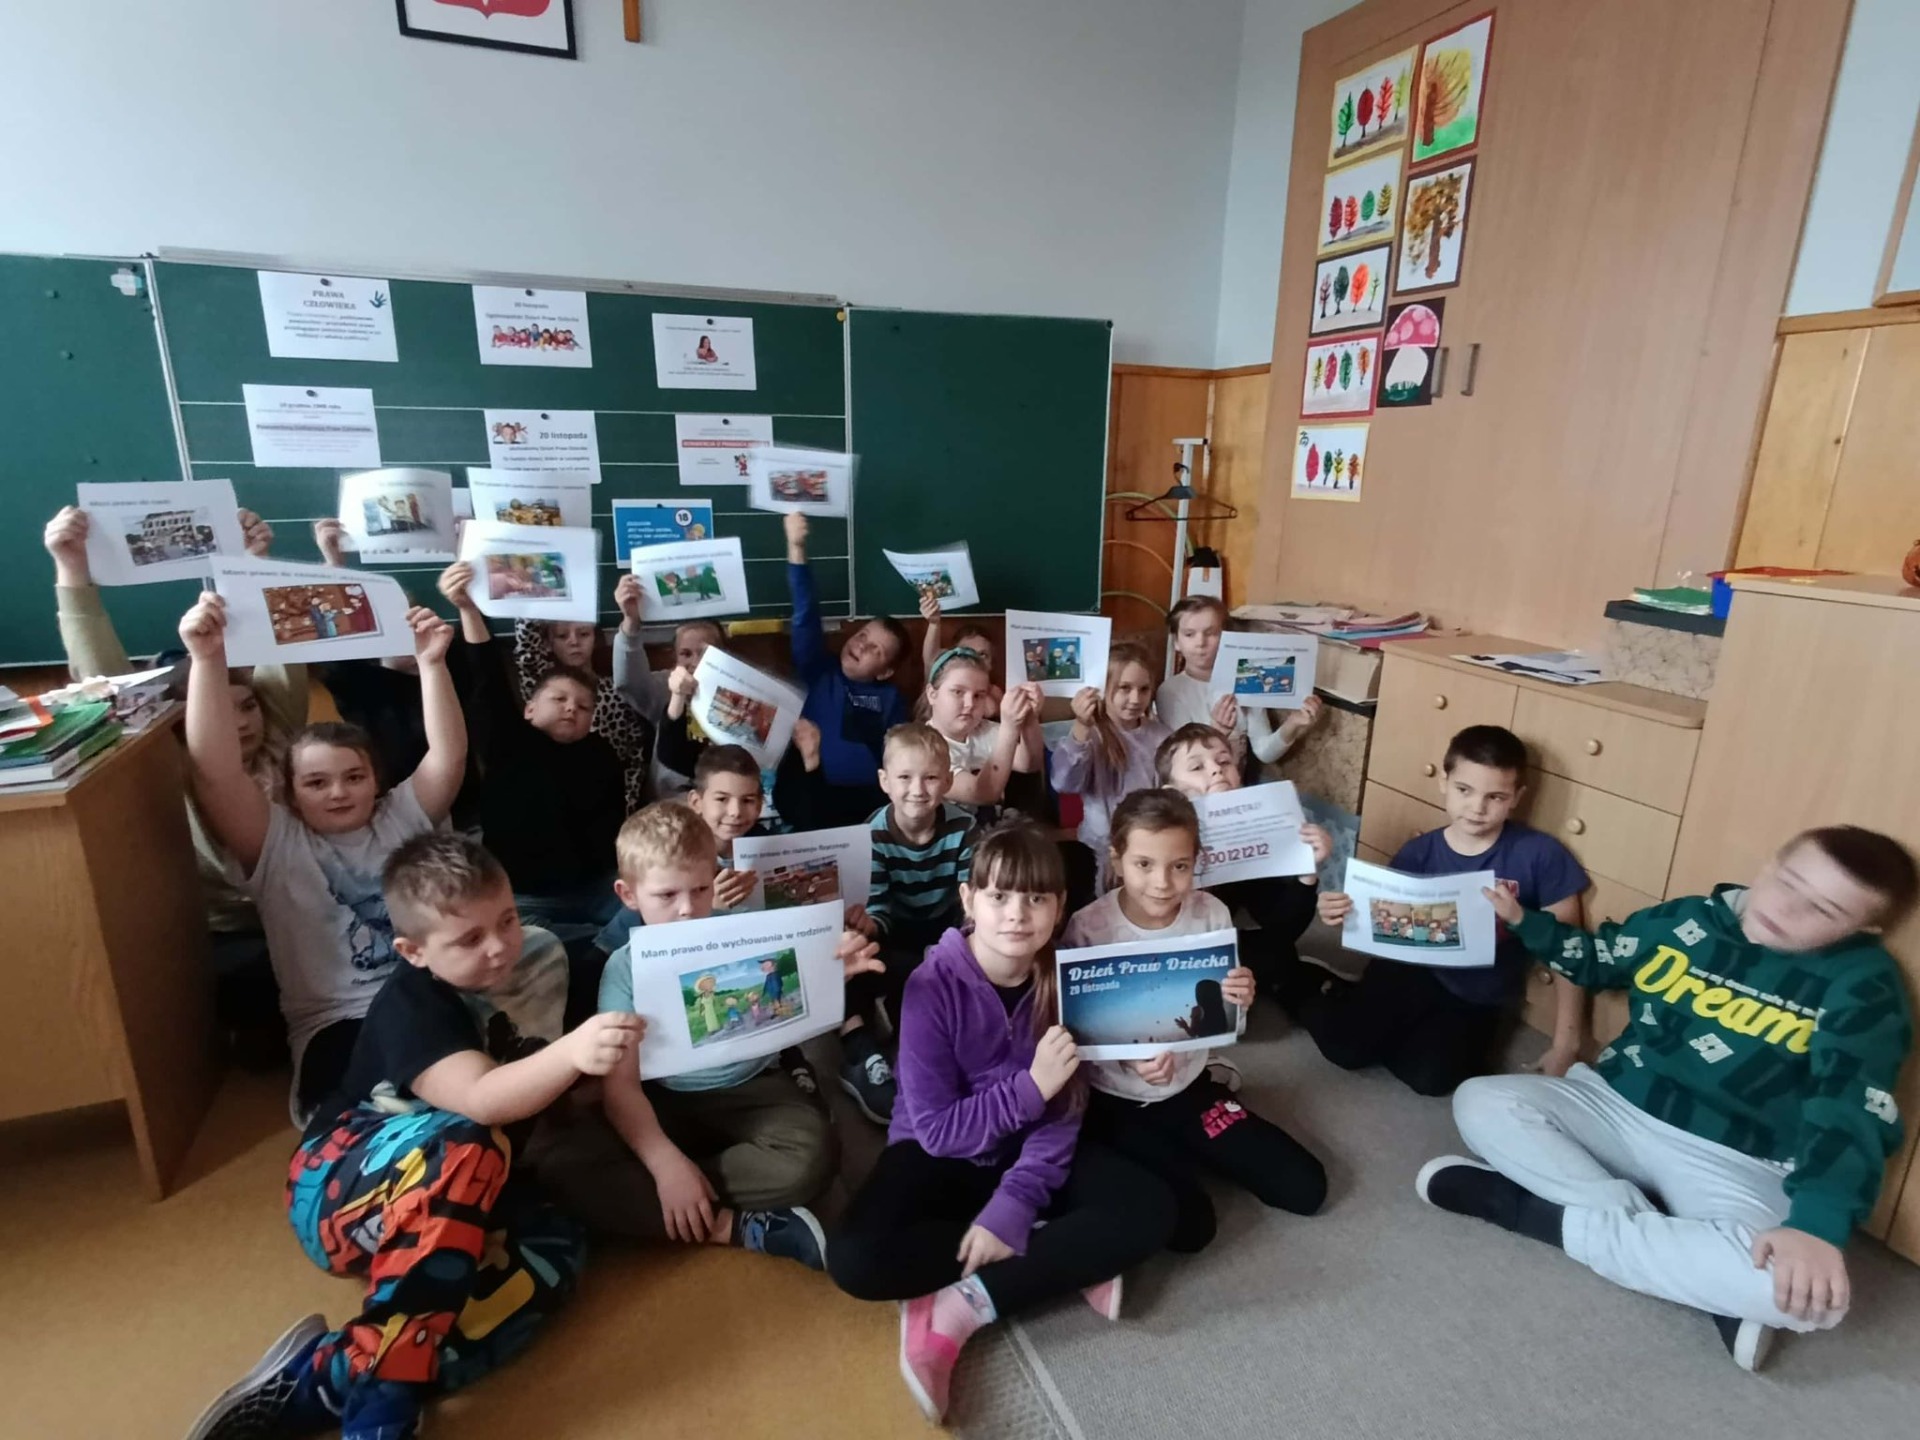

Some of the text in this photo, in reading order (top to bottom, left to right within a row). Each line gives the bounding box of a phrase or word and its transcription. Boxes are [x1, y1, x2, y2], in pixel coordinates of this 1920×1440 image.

[551, 432, 588, 440] listopada
[677, 513, 689, 522] 18
[641, 925, 833, 960] Mam prawo do wychowania w rodzinie
[1068, 954, 1229, 982] Dzień Praw Dziecka
[1069, 980, 1120, 996] 20 listopada
